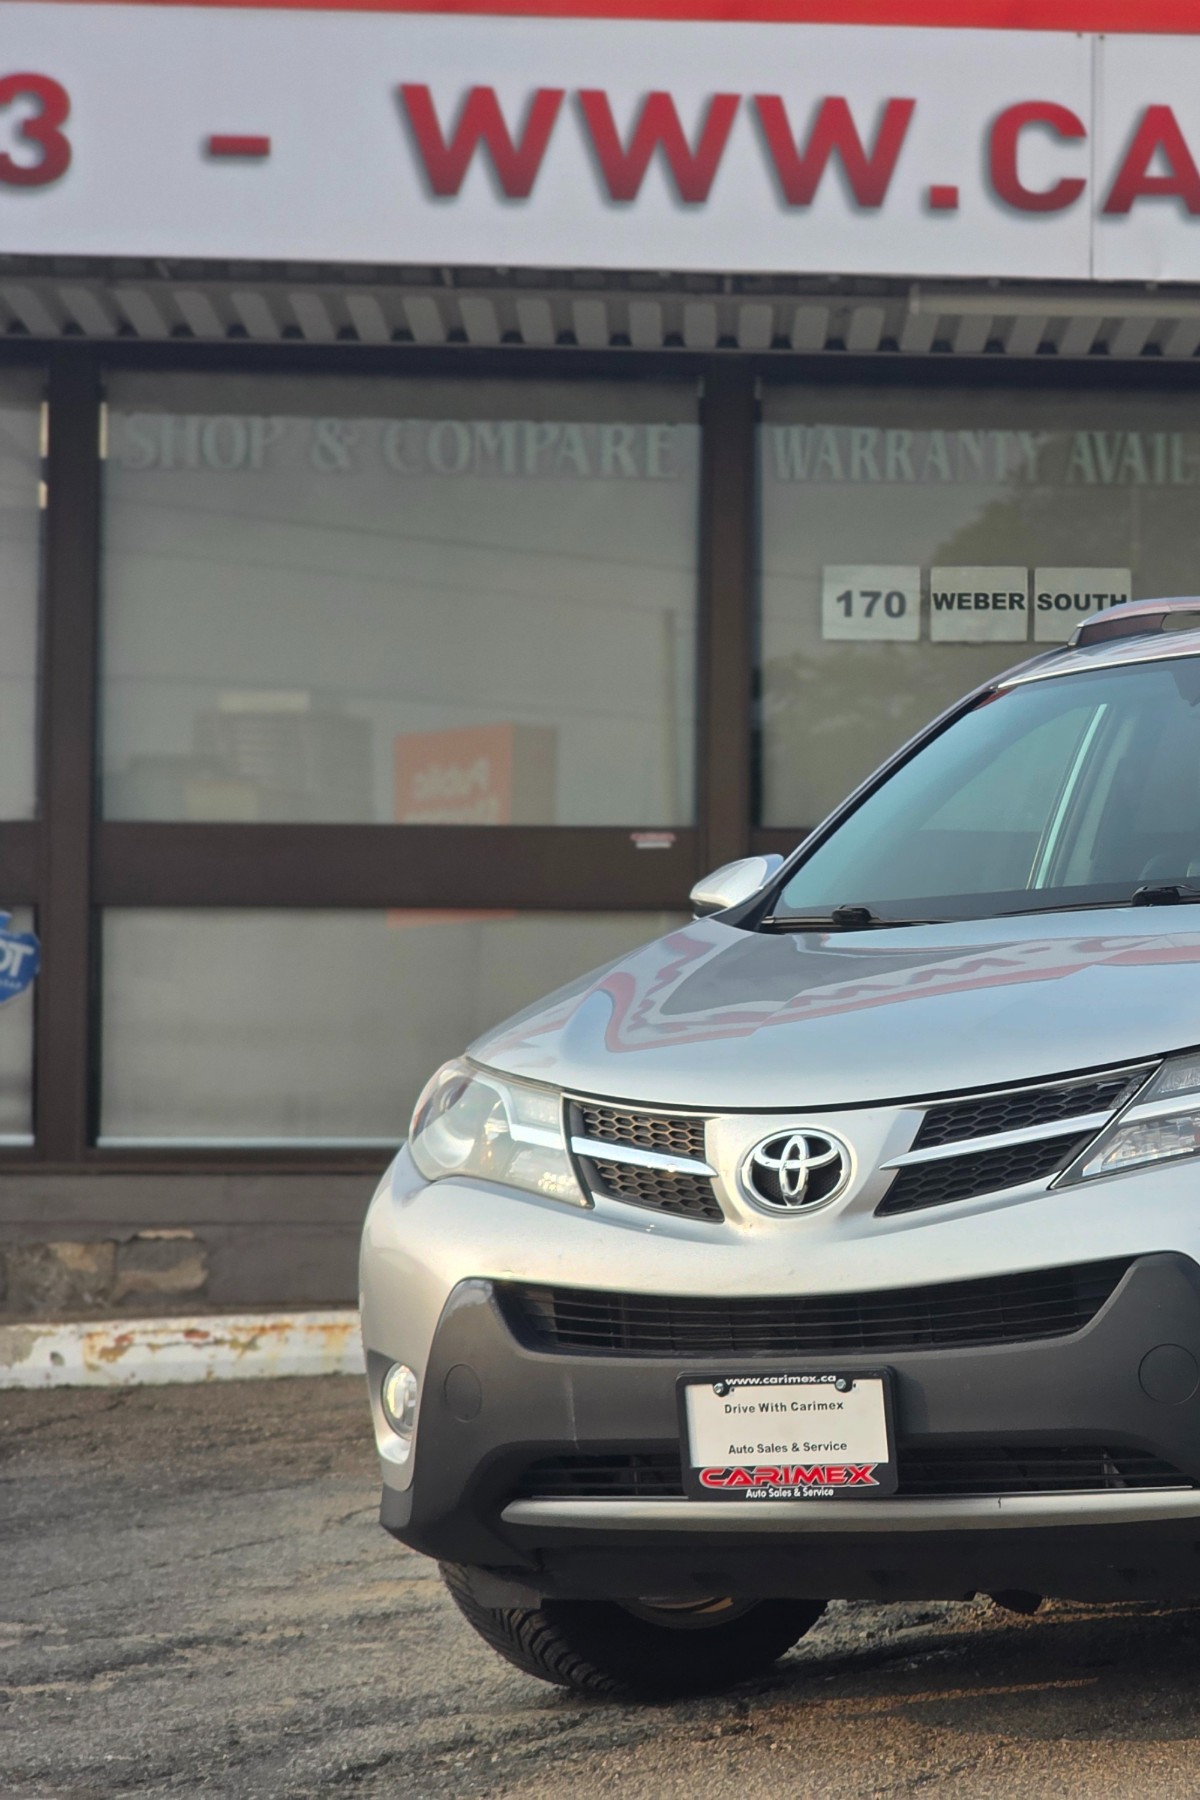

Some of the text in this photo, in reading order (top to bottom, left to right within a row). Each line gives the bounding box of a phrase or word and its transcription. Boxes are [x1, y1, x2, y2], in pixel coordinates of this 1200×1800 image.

[122, 413, 680, 479] SHOP & COMPARE
[772, 426, 1041, 482] WARRANTY
[834, 589, 1129, 618] 170 WEBER SOUTH
[725, 1374, 837, 1386] www.carimex.ca
[724, 1401, 844, 1414] Drive With Carimex
[728, 1441, 848, 1455] Auto Sales & Service
[699, 1463, 881, 1489] CARIMEX
[745, 1485, 834, 1499] Auto Sales & Service
